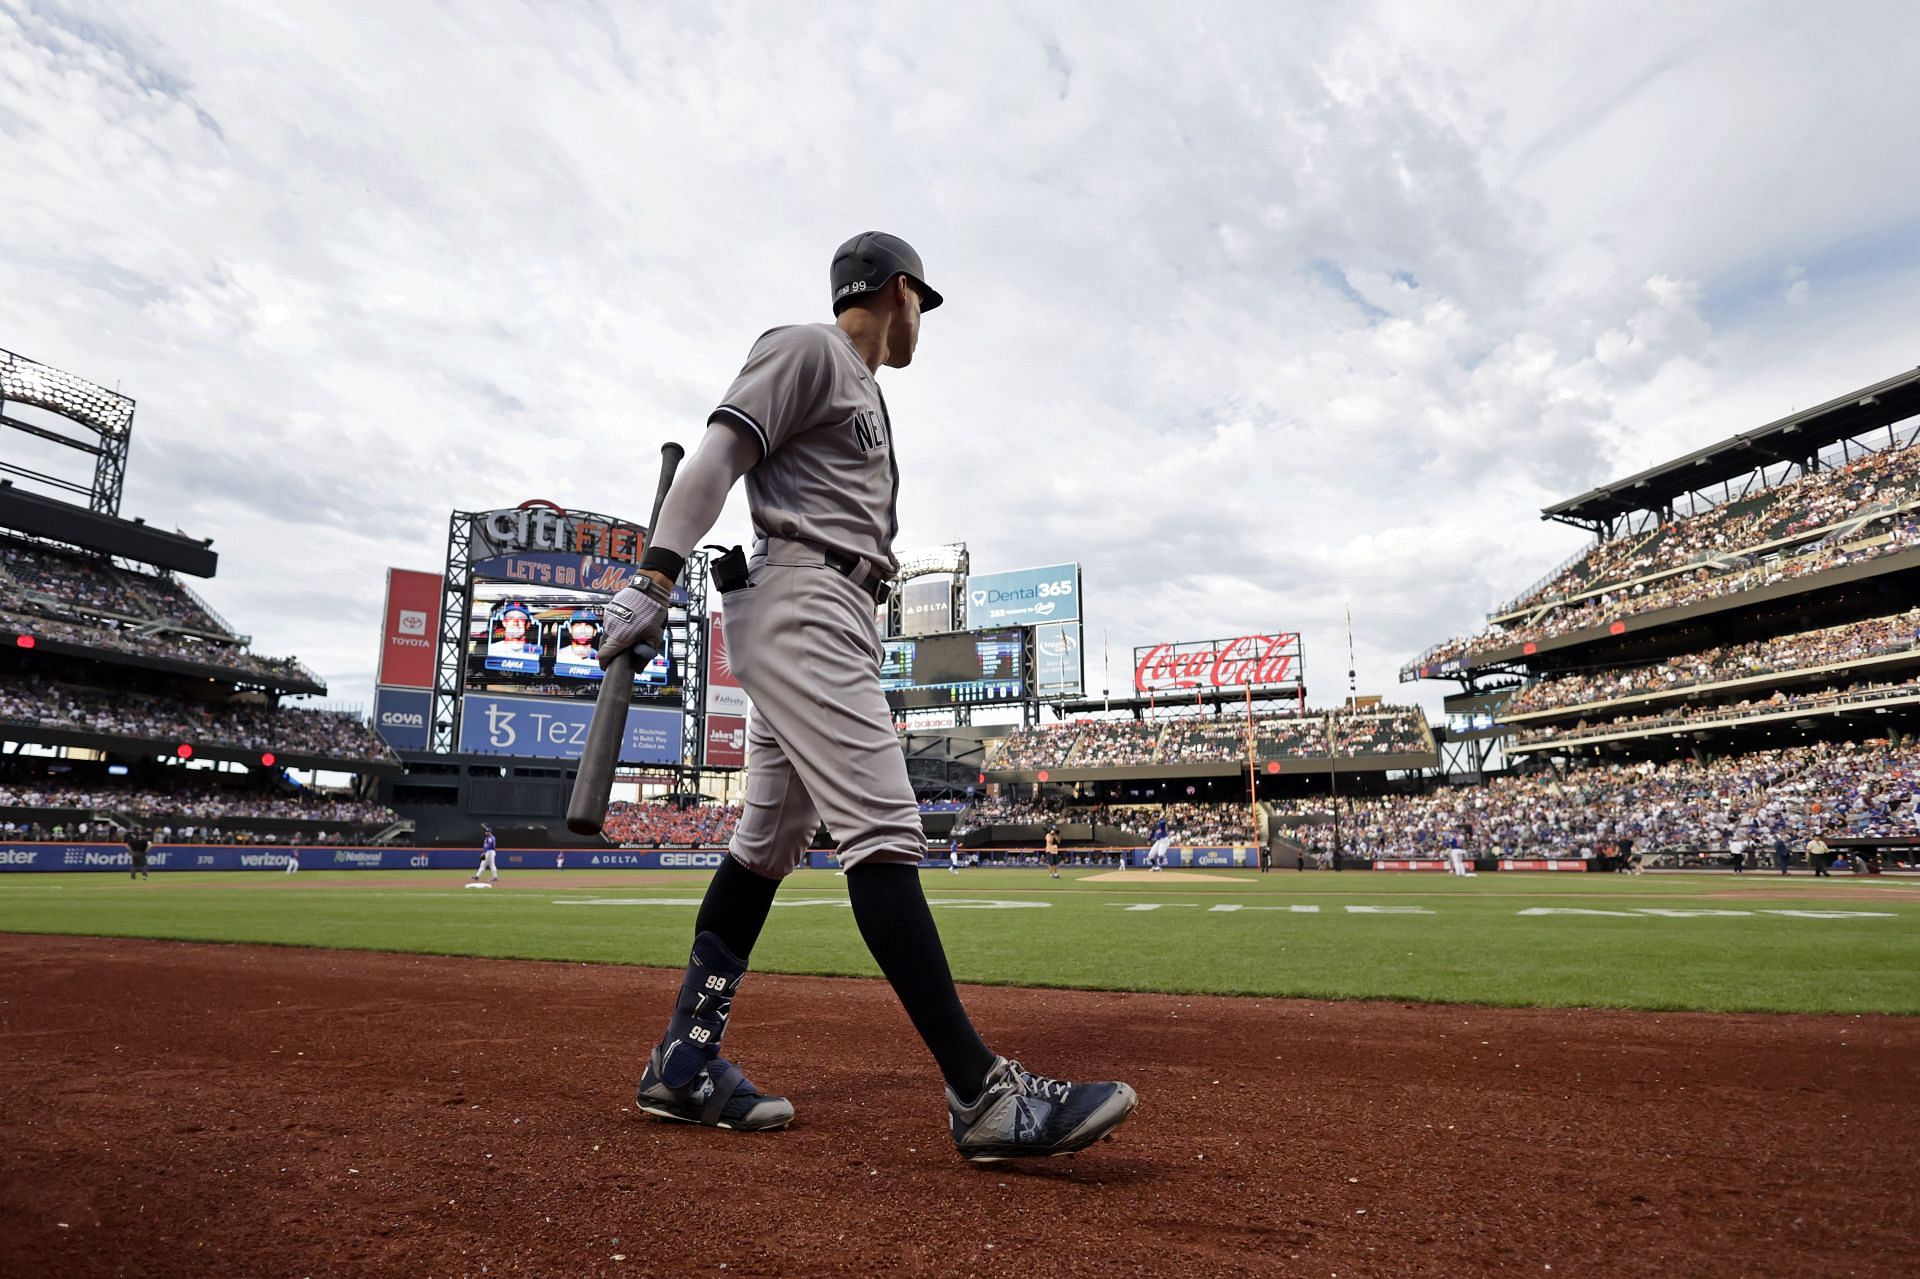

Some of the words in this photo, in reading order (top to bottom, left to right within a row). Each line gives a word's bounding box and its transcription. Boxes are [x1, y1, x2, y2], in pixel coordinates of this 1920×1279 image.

[852, 281, 866, 292] 99
[487, 509, 564, 549] citi
[576, 522, 645, 563] FIE
[506, 559, 551, 582] LET'S
[555, 565, 576, 586] GO
[591, 566, 633, 592] Me
[916, 602, 948, 613] DELTA
[392, 637, 430, 648] TOYOTA
[1135, 633, 1300, 692] Coca-Cola
[720, 696, 744, 706] Affinity
[382, 712, 423, 725] GOYA
[529, 713, 588, 745] Tez
[85, 852, 166, 865] Northell
[410, 854, 428, 867] citi
[603, 855, 638, 864] DELTA
[659, 853, 721, 866] GEICO
[705, 975, 726, 991] 99
[689, 1025, 710, 1043] 99
